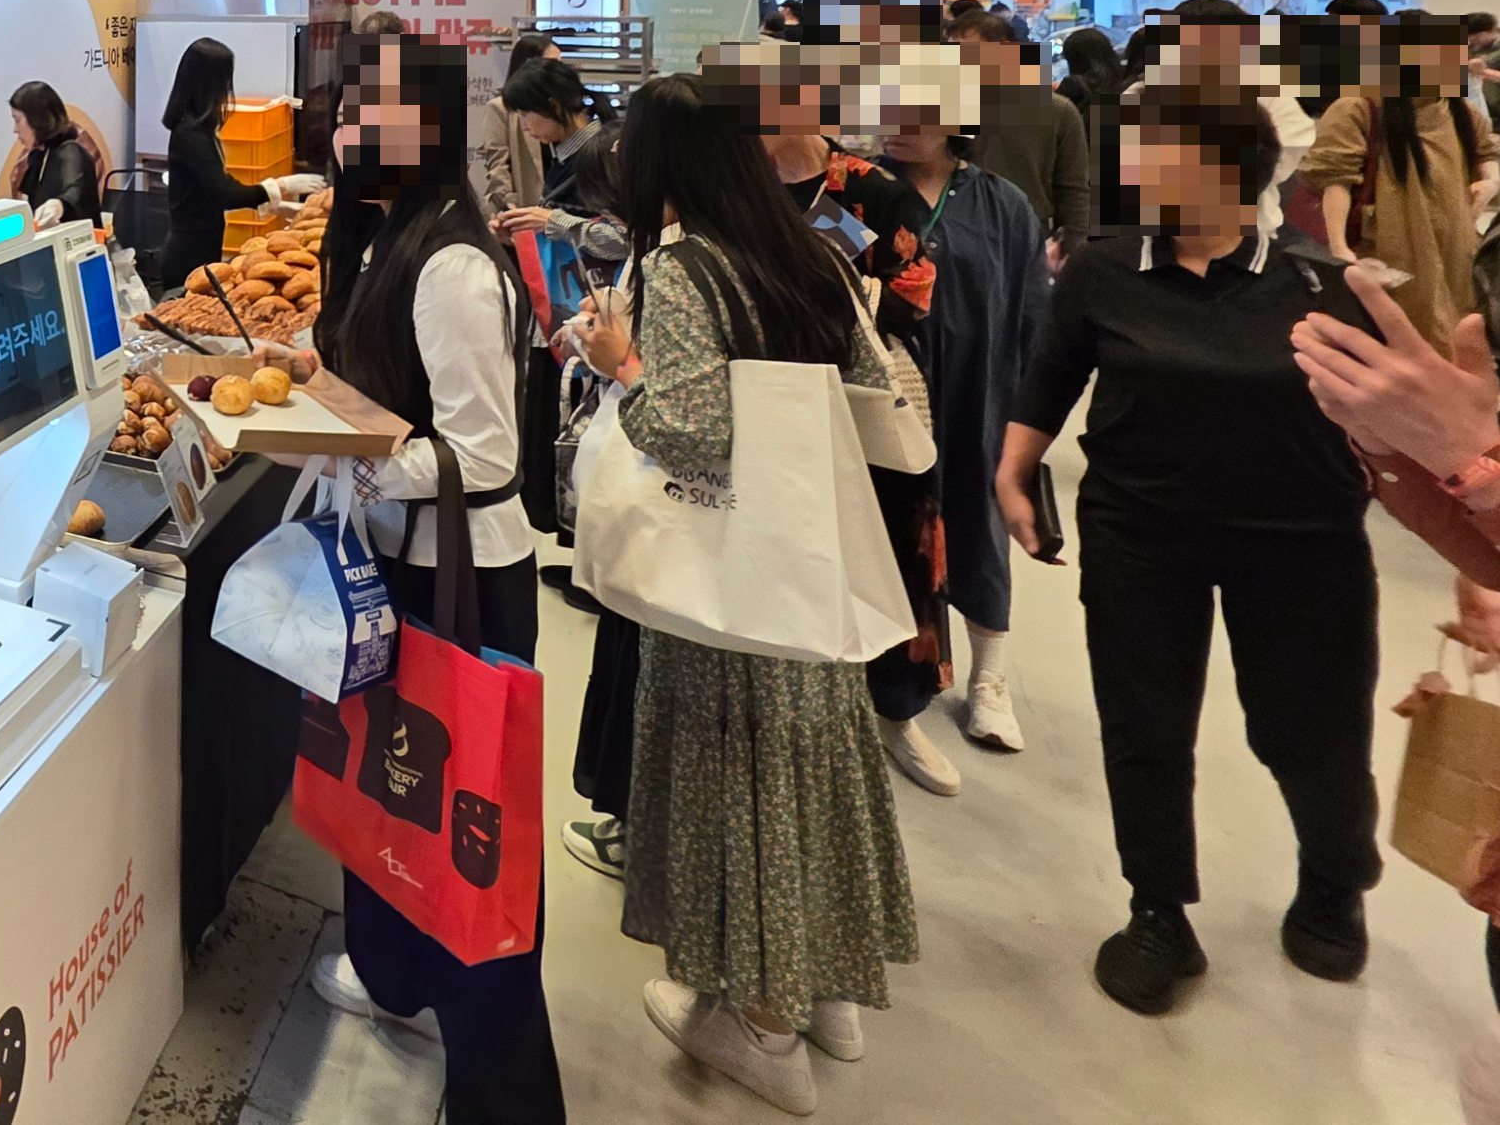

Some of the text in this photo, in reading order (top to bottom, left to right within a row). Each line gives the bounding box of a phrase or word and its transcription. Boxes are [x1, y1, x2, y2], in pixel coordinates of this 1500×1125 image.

[84, 47, 120, 71] 가드니아
[48, 856, 133, 1023] House of
[48, 893, 145, 1083] PATISSIER
